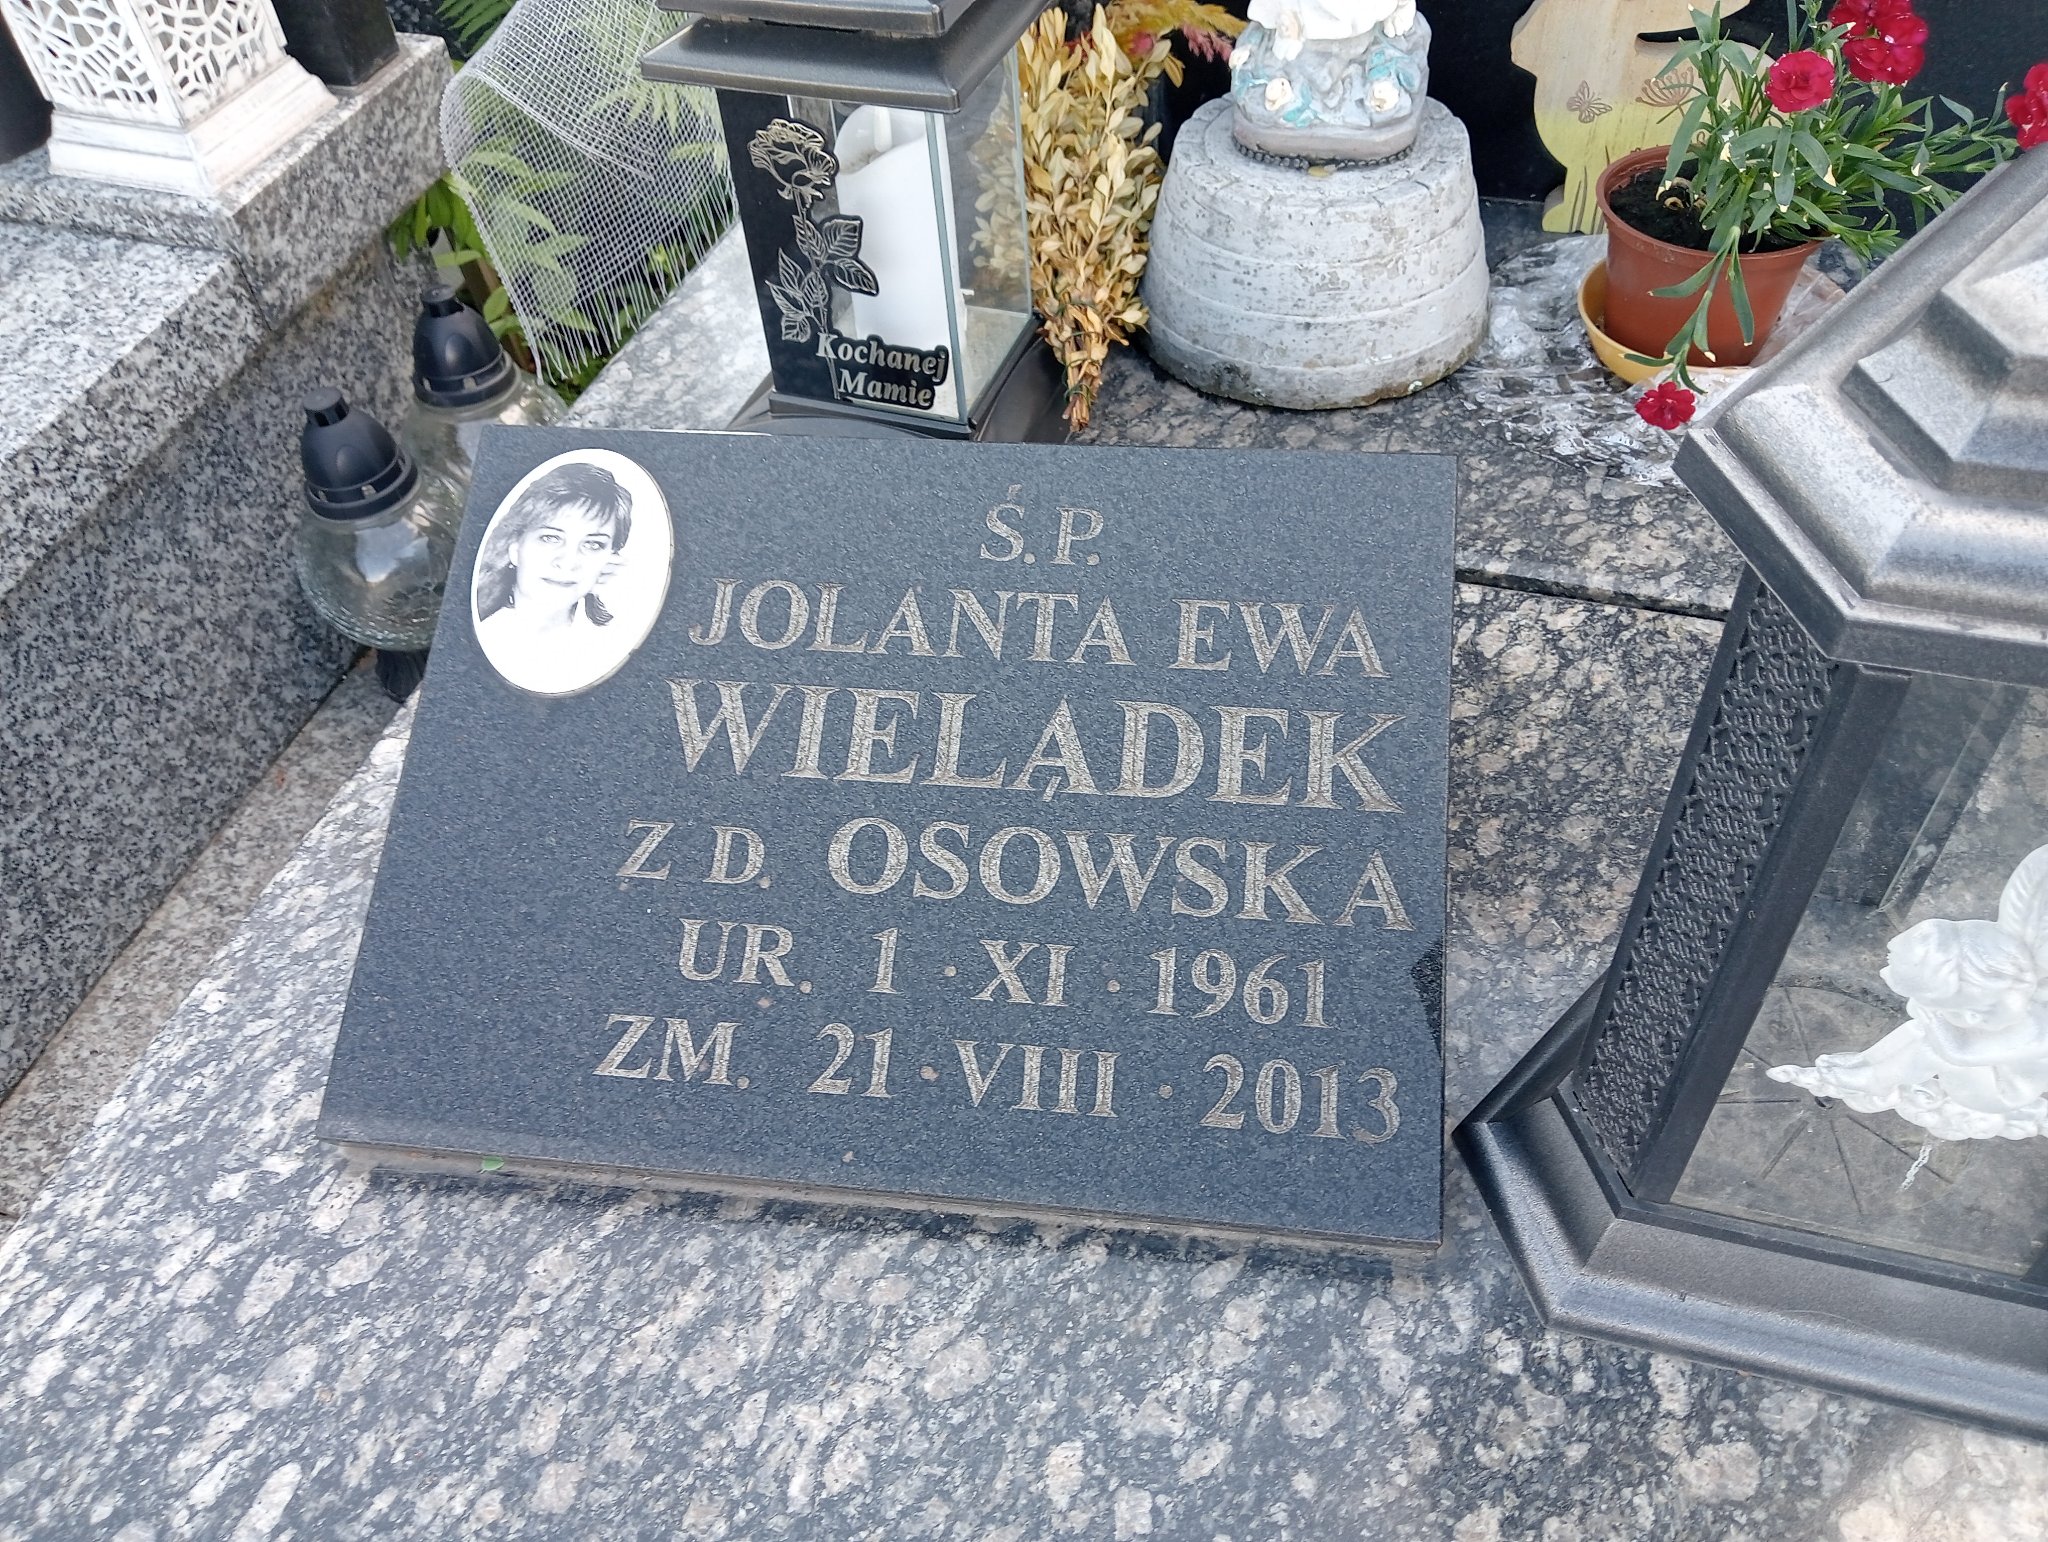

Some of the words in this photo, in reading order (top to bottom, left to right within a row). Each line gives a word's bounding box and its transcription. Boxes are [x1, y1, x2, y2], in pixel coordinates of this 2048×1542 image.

[816, 332, 946, 382] Kochanej
[839, 368, 932, 406] Mamie
[689, 577, 1136, 666] JOLANTA
[1171, 598, 1389, 679] EWA
[667, 678, 1406, 813] WIELĄDEK
[616, 820, 674, 881] Z
[703, 825, 771, 889] D.
[828, 817, 1414, 931] OSOWSKA
[679, 917, 813, 994] UR.
[871, 927, 899, 994] 1
[972, 939, 1075, 1007] XI
[1147, 948, 1330, 1029] 1961
[593, 1014, 750, 1090] ZM.
[808, 1023, 894, 1099] 21
[955, 1040, 1120, 1118] VIII
[1202, 1053, 1400, 1145] 2013
